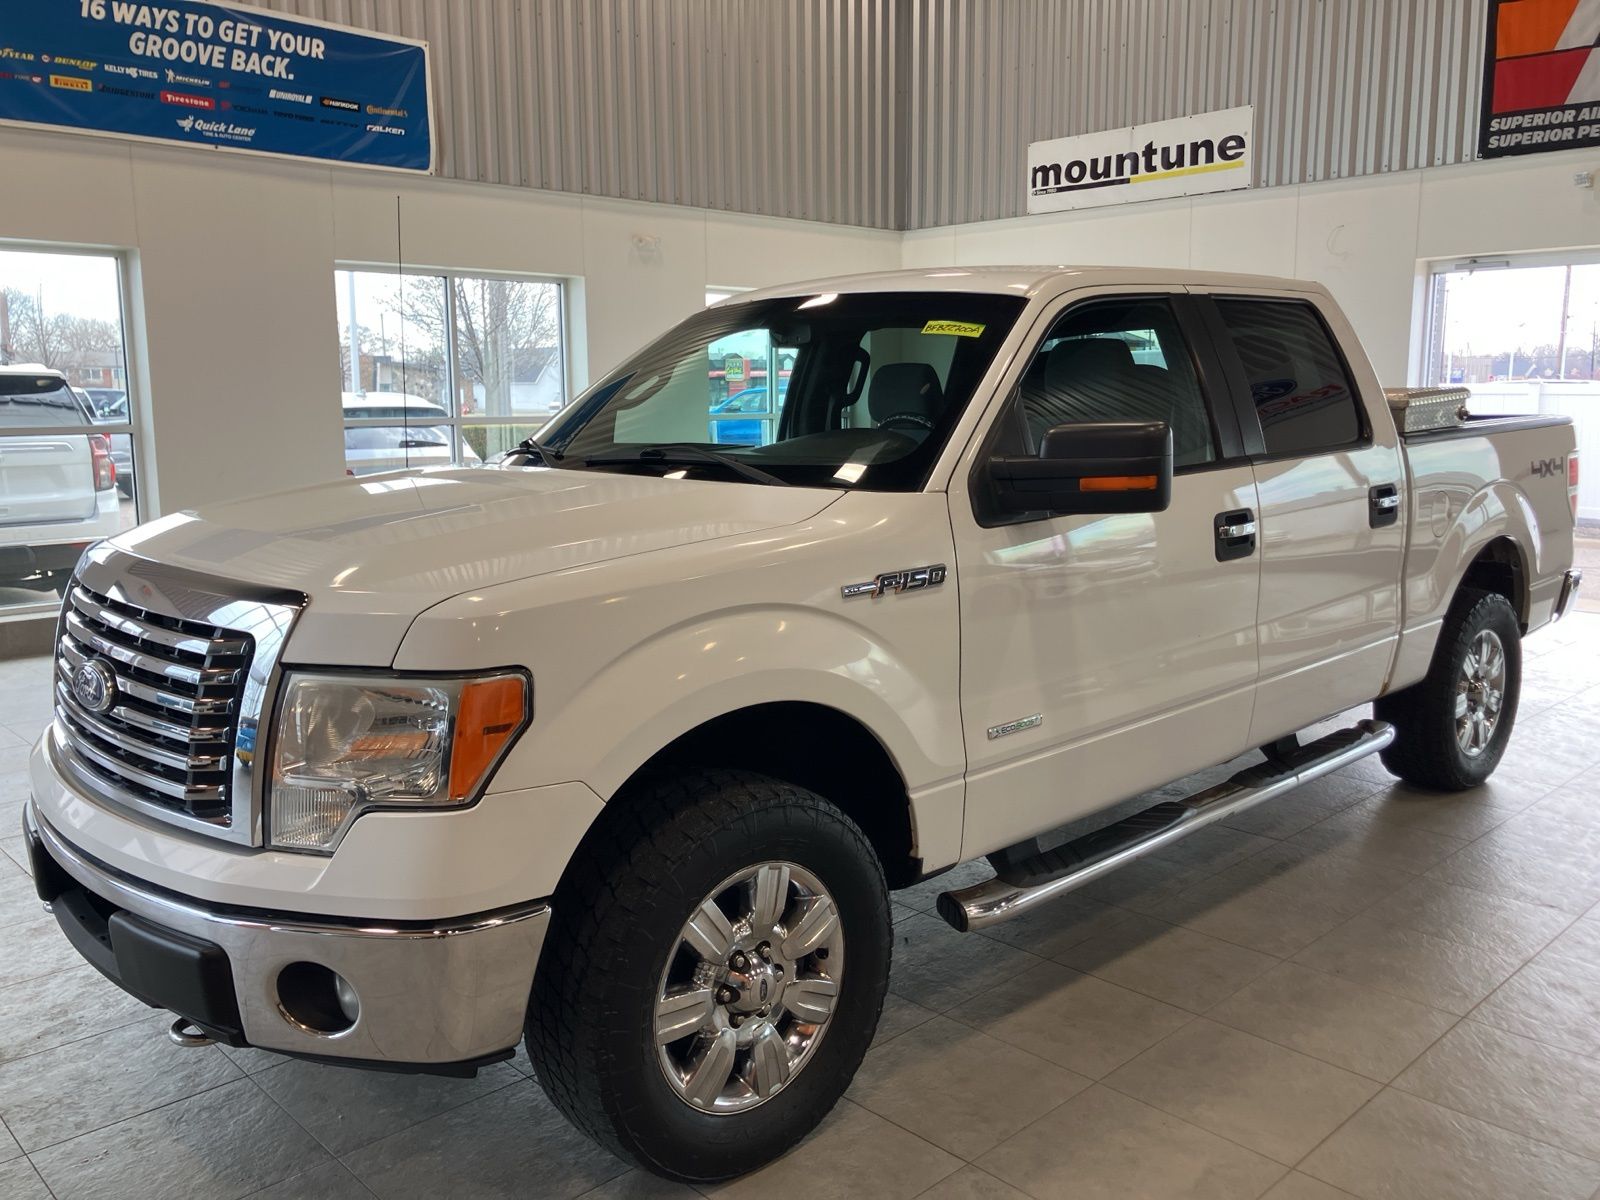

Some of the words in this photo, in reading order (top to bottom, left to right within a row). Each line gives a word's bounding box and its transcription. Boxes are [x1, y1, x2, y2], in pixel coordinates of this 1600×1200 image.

[80, 0, 106, 20] 16
[112, 1, 179, 33] WAYS
[184, 13, 214, 39] TO
[218, 20, 262, 47] GET
[267, 29, 325, 60] YOUR
[54, 56, 97, 70] DUNLOP
[129, 31, 226, 69] GROOVE
[231, 50, 294, 80] BACK.
[138, 69, 158, 79] TIRES
[175, 75, 210, 86] MICHELIN
[194, 119, 226, 133] Quick
[227, 124, 256, 137] Lane
[366, 124, 405, 136] FALKEN
[1489, 109, 1577, 132] SUPERIOR
[1488, 127, 1575, 149] SUPERIOR
[1032, 135, 1246, 189] mountune
